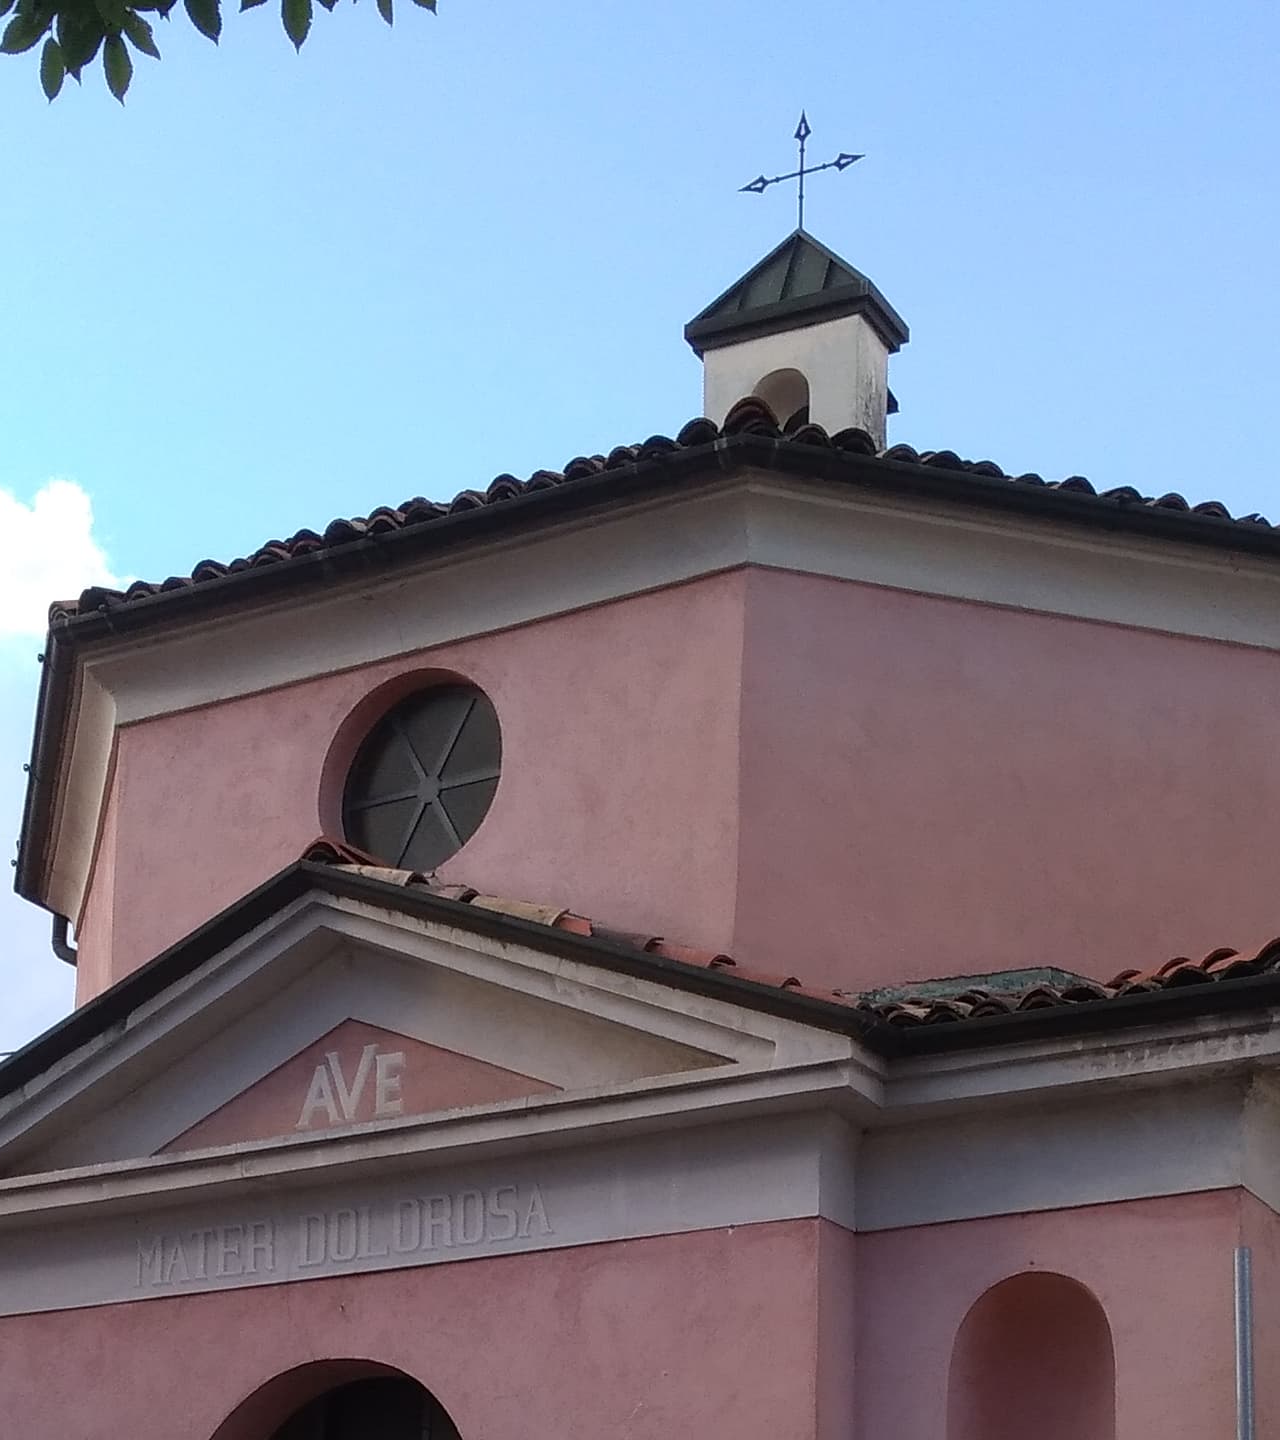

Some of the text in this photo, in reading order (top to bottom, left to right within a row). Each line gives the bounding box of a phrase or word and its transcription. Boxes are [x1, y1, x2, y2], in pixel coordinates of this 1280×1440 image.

[295, 1043, 406, 1131] AVE
[133, 1182, 555, 1289] MATER DOLOROSA
